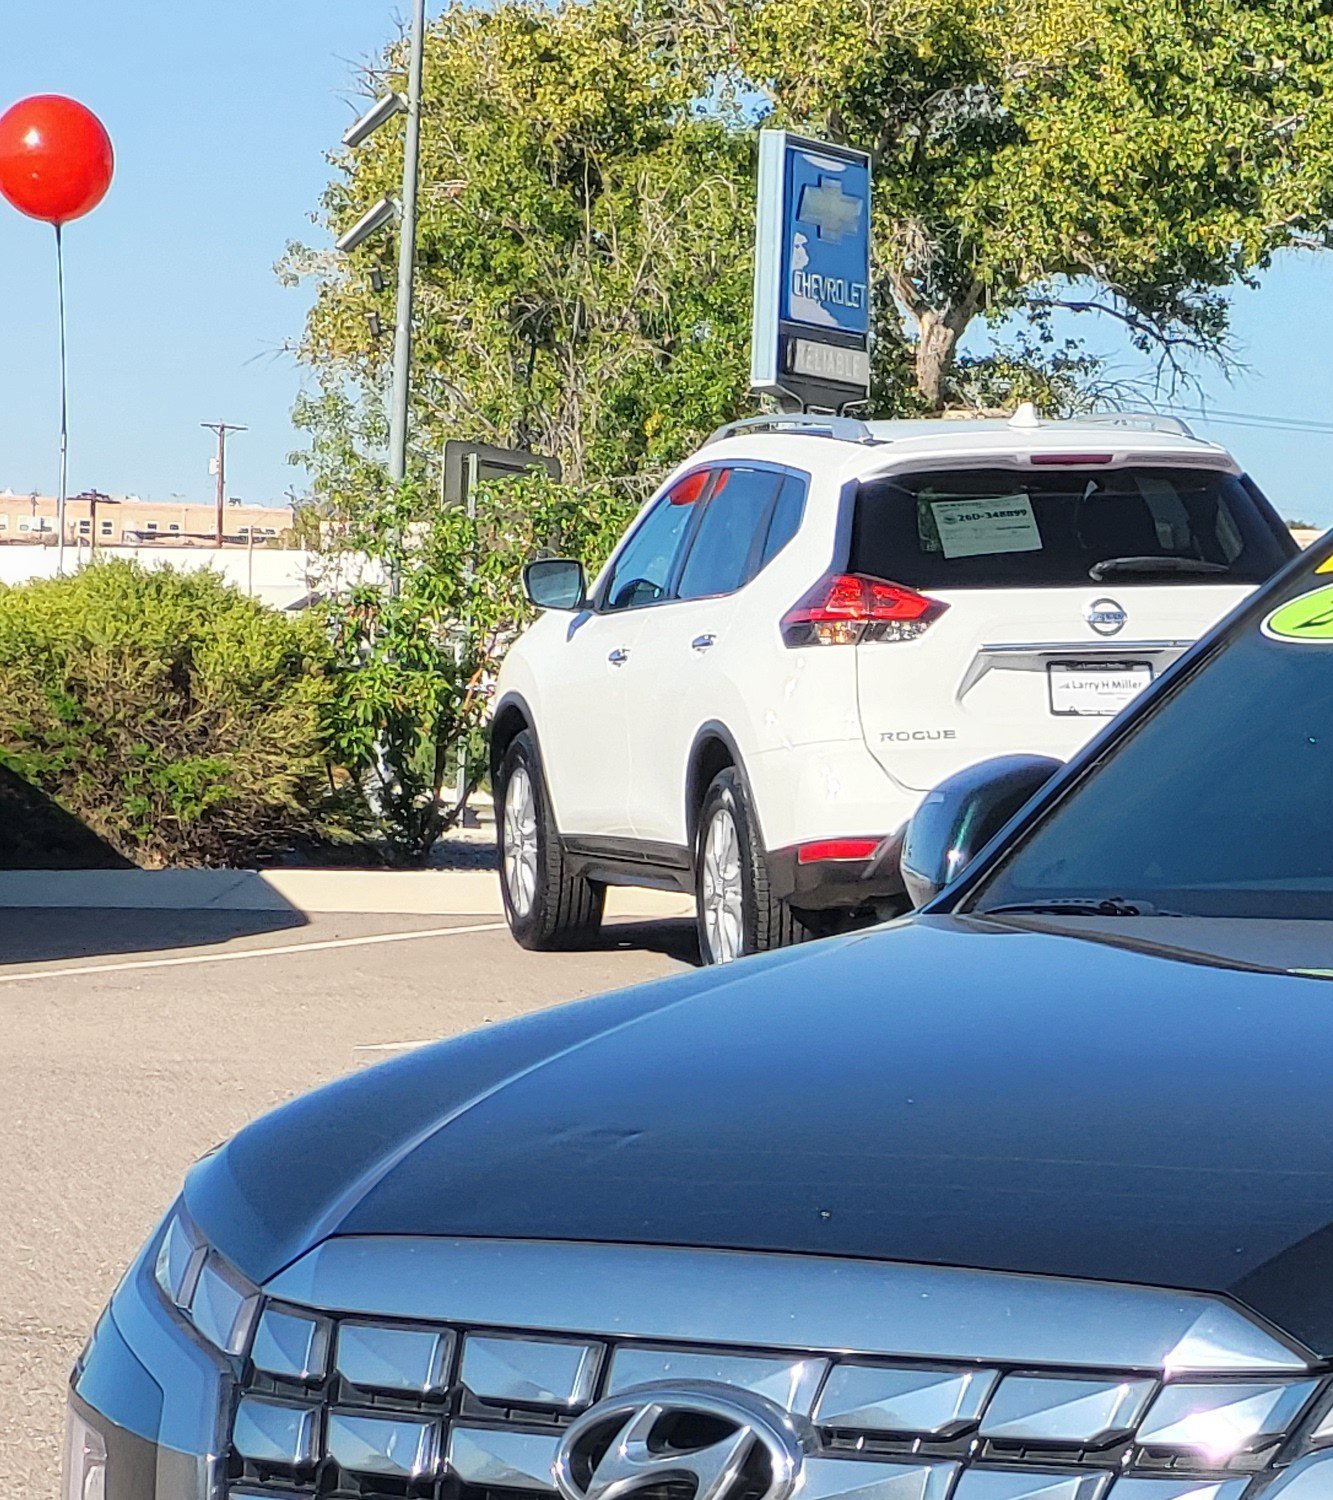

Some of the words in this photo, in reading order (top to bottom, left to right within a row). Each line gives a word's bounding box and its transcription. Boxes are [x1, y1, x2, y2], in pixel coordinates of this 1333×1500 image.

[793, 269, 867, 309] CHEVROLET
[1072, 680, 1099, 691] Larry
[1102, 680, 1110, 689] H
[1112, 679, 1142, 689] Miller
[879, 729, 957, 742] ROGUE
